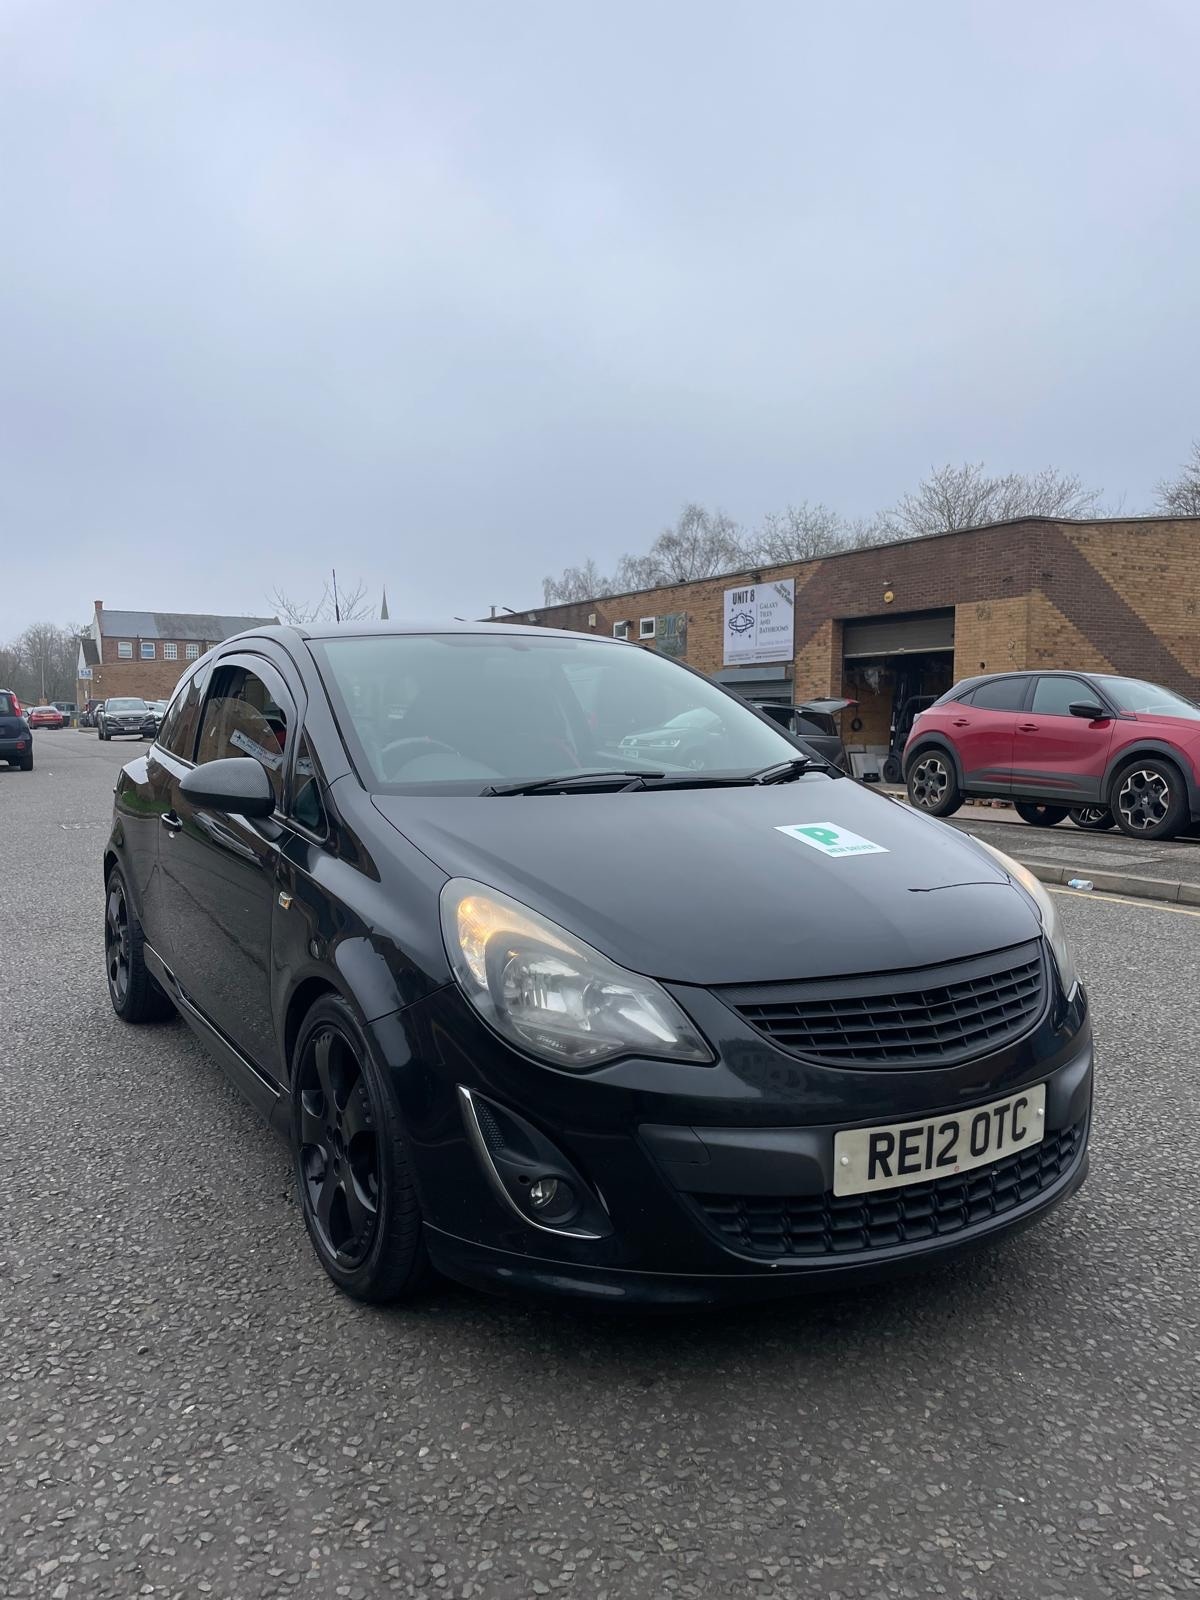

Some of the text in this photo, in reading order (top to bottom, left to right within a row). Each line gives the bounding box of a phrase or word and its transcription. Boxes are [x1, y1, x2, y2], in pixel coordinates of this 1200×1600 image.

[732, 589, 755, 605] UNIT 8
[759, 626, 789, 634] BATHROOMS
[794, 827, 840, 846] P
[867, 1096, 1028, 1180] RE12 OTC
